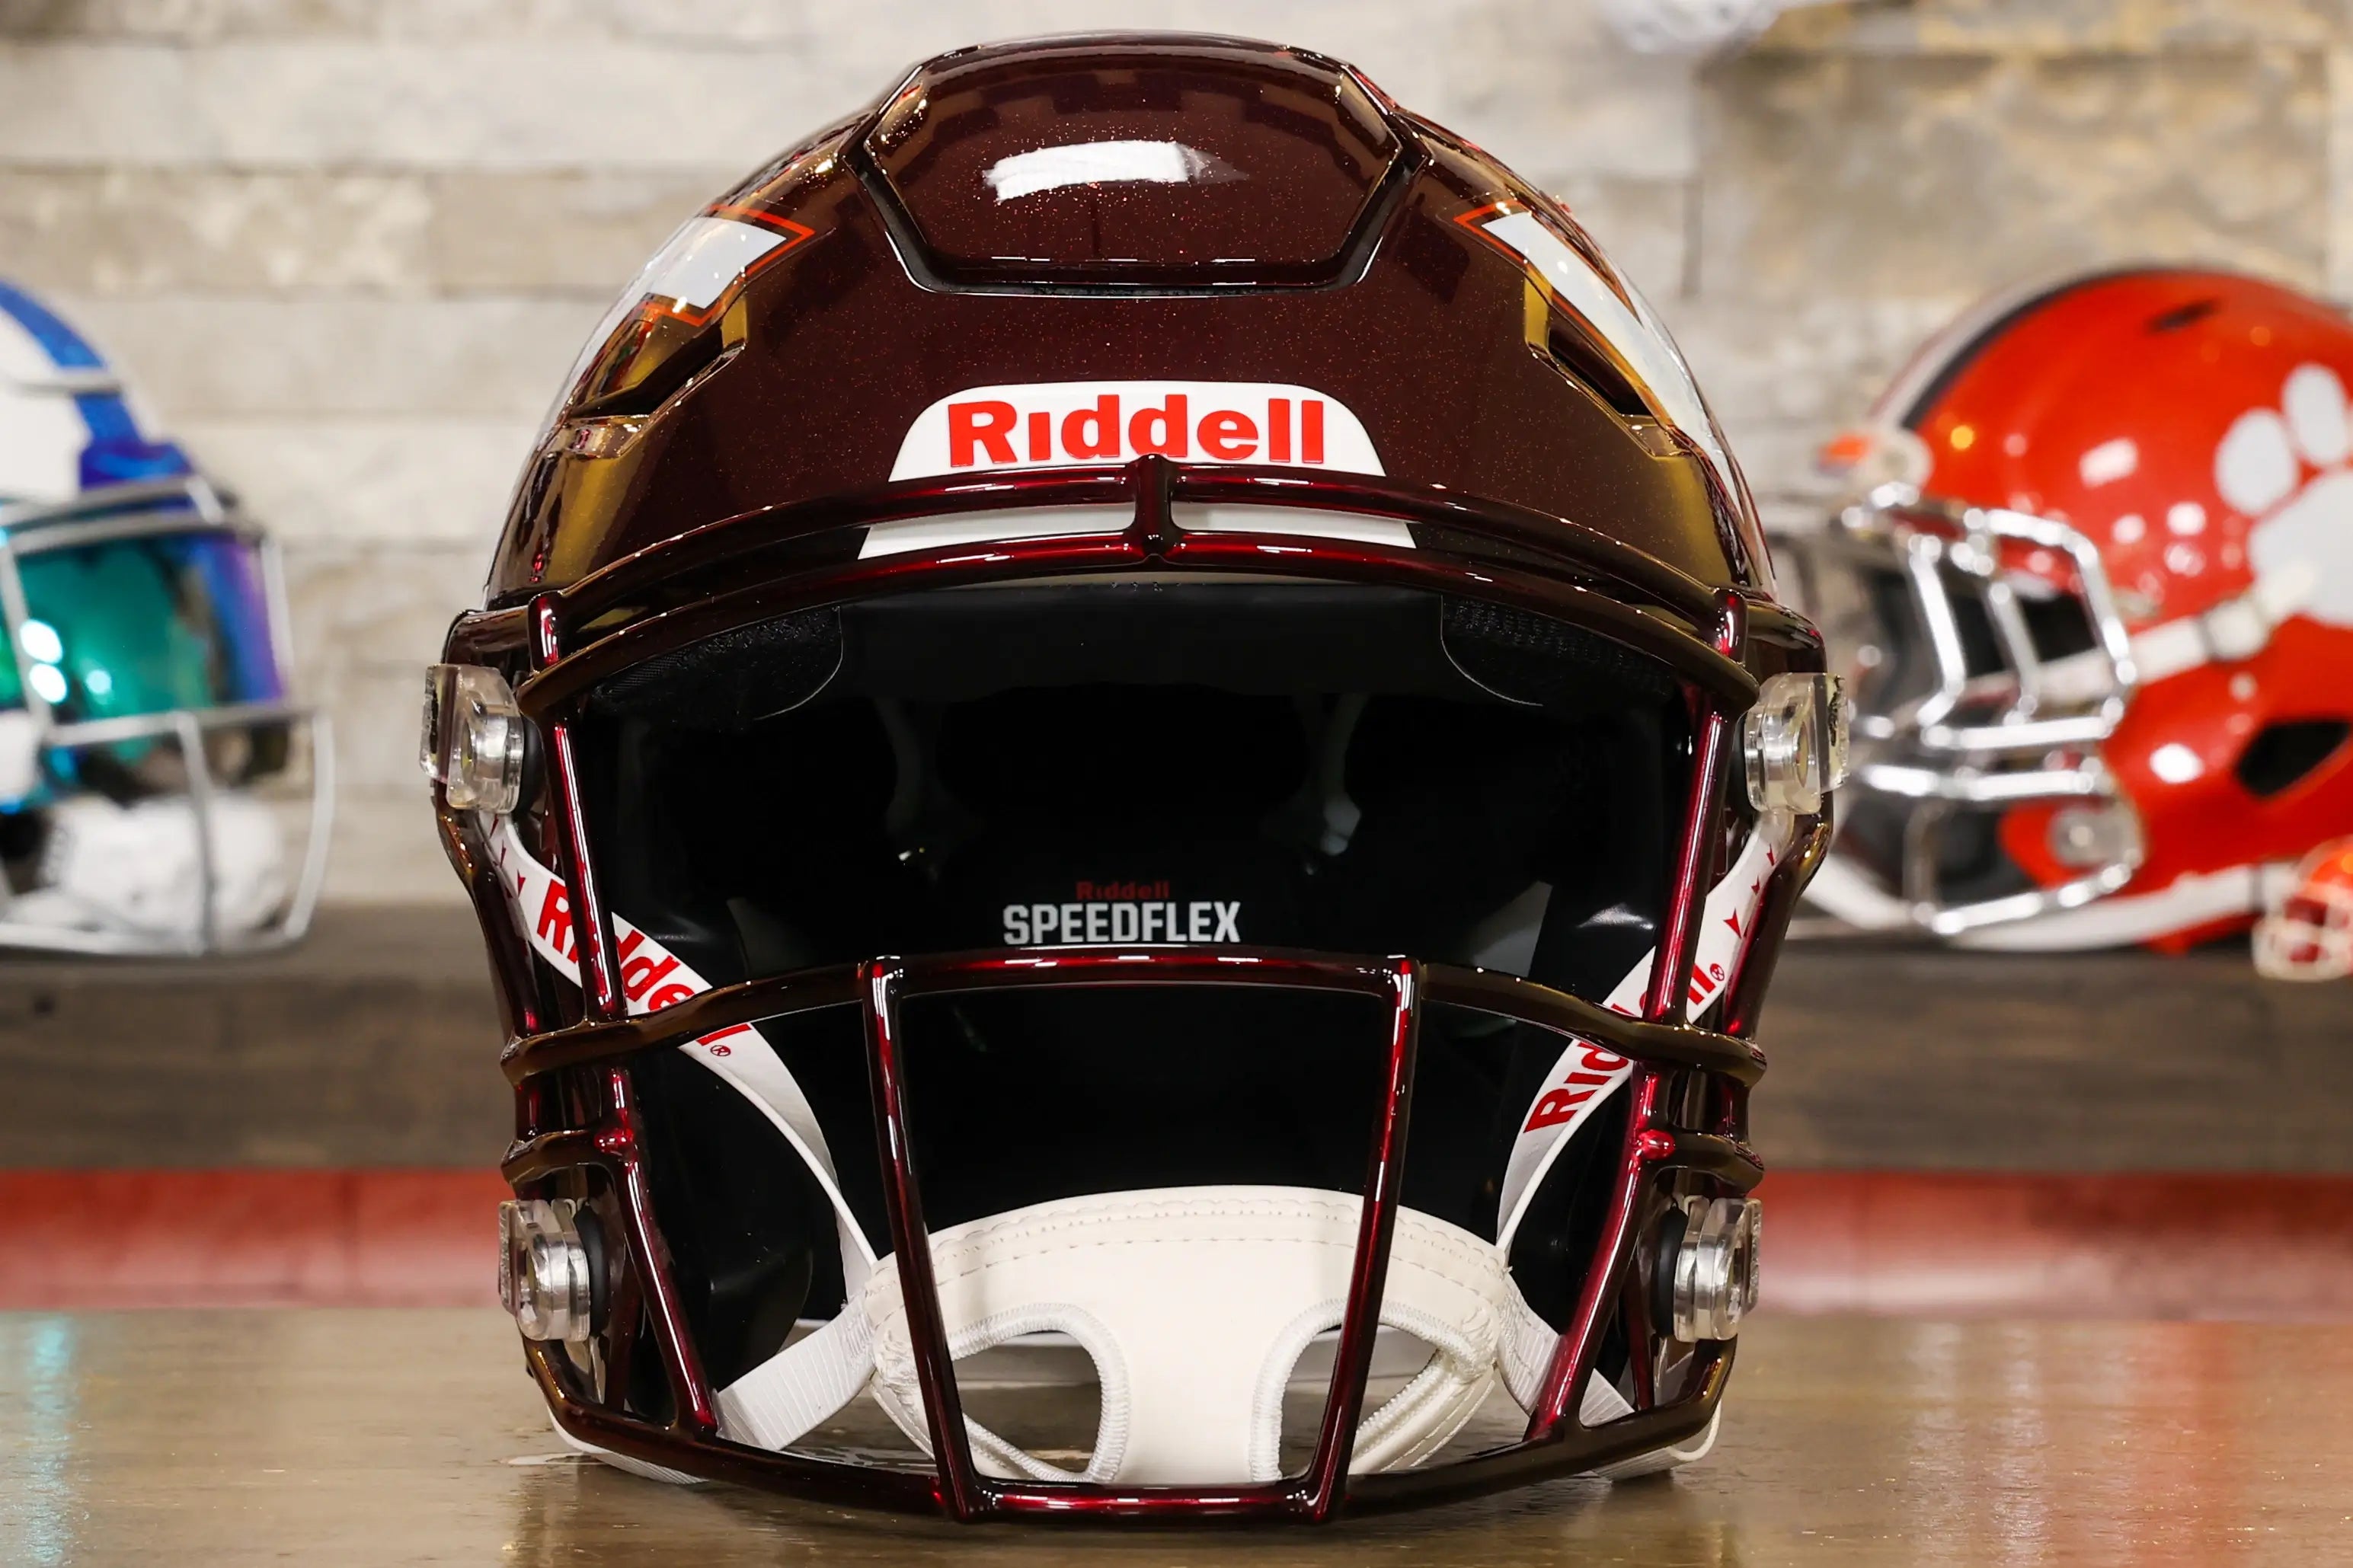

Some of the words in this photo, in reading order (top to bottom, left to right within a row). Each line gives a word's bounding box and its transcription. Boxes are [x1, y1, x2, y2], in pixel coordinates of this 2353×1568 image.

[948, 394, 1325, 467] Riddell
[1076, 881, 1169, 900] Riddell
[1002, 902, 1241, 945] SPEEDFLEX
